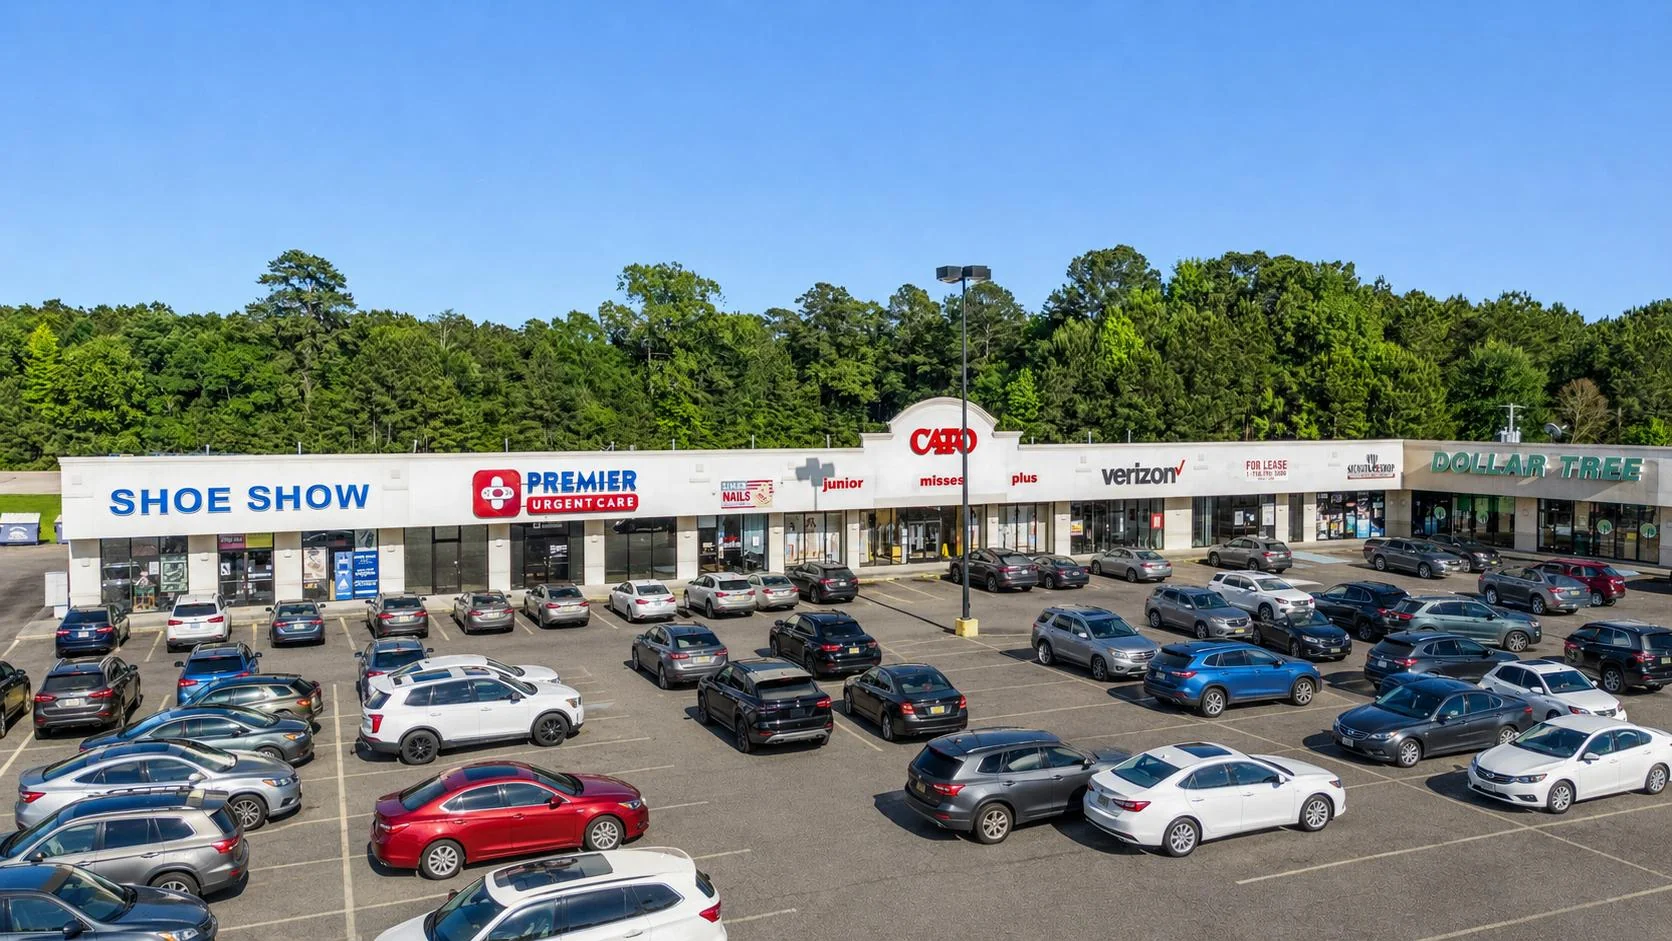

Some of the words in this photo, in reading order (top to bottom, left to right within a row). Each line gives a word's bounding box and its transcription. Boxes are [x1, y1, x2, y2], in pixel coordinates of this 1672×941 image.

[910, 428, 978, 455] CATO
[1102, 462, 1176, 485] verizon
[1246, 460, 1261, 470] FOR
[1263, 460, 1288, 470] LEASE
[1430, 452, 1548, 478] DOLLAR
[1560, 455, 1645, 481] TREE
[527, 469, 637, 494] PREMIER
[822, 476, 864, 493] junior
[919, 474, 965, 487] misses
[1011, 472, 1038, 486] plus
[109, 486, 232, 516] SHOE
[247, 483, 370, 512] SHOW
[532, 498, 593, 510] URGENT
[596, 497, 634, 508] CARE
[722, 491, 751, 502] NAILS
